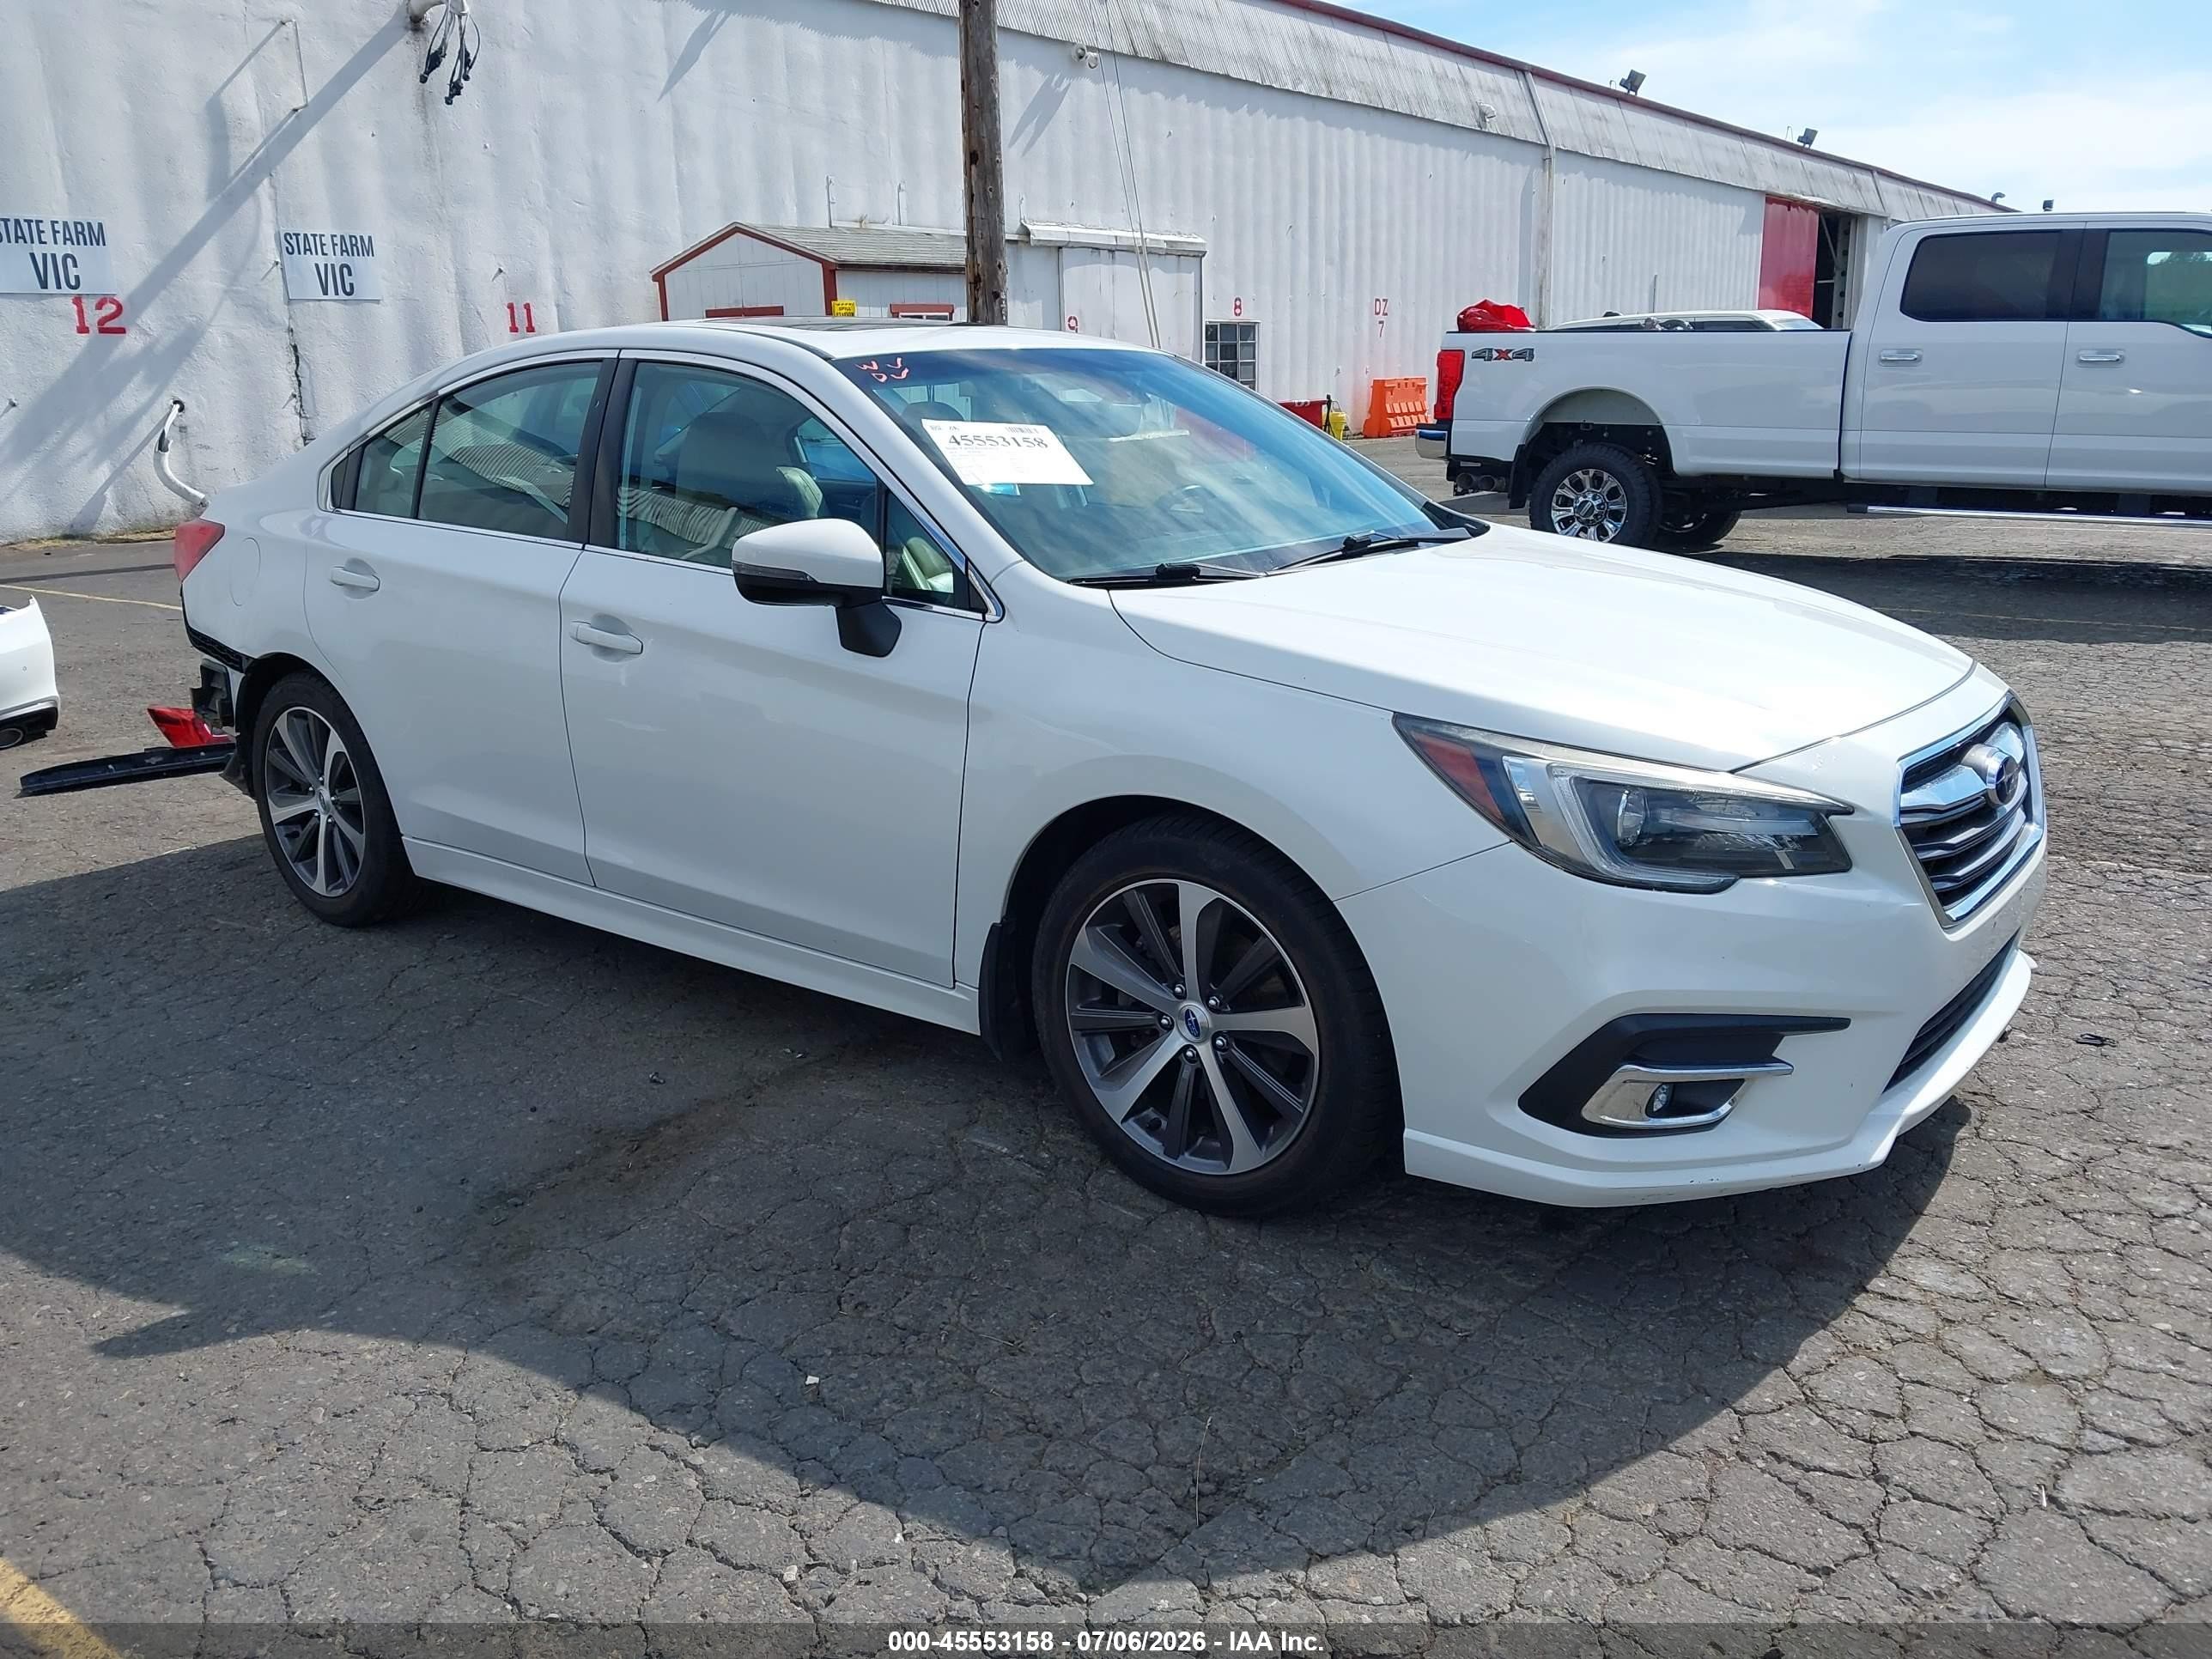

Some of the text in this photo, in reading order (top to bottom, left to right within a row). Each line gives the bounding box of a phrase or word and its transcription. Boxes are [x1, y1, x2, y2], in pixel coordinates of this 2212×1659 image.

[0, 217, 106, 246] TATE FARM
[283, 232, 374, 257] STATE FARM
[29, 252, 81, 290] VIC
[314, 262, 355, 296] VIC
[71, 295, 126, 334] 12
[507, 302, 536, 333] 11
[1233, 296, 1243, 317] 8
[1374, 298, 1389, 317] DZ
[1067, 315, 1079, 334] 9
[1378, 320, 1385, 337] 7
[948, 434, 1048, 449] 45553158
